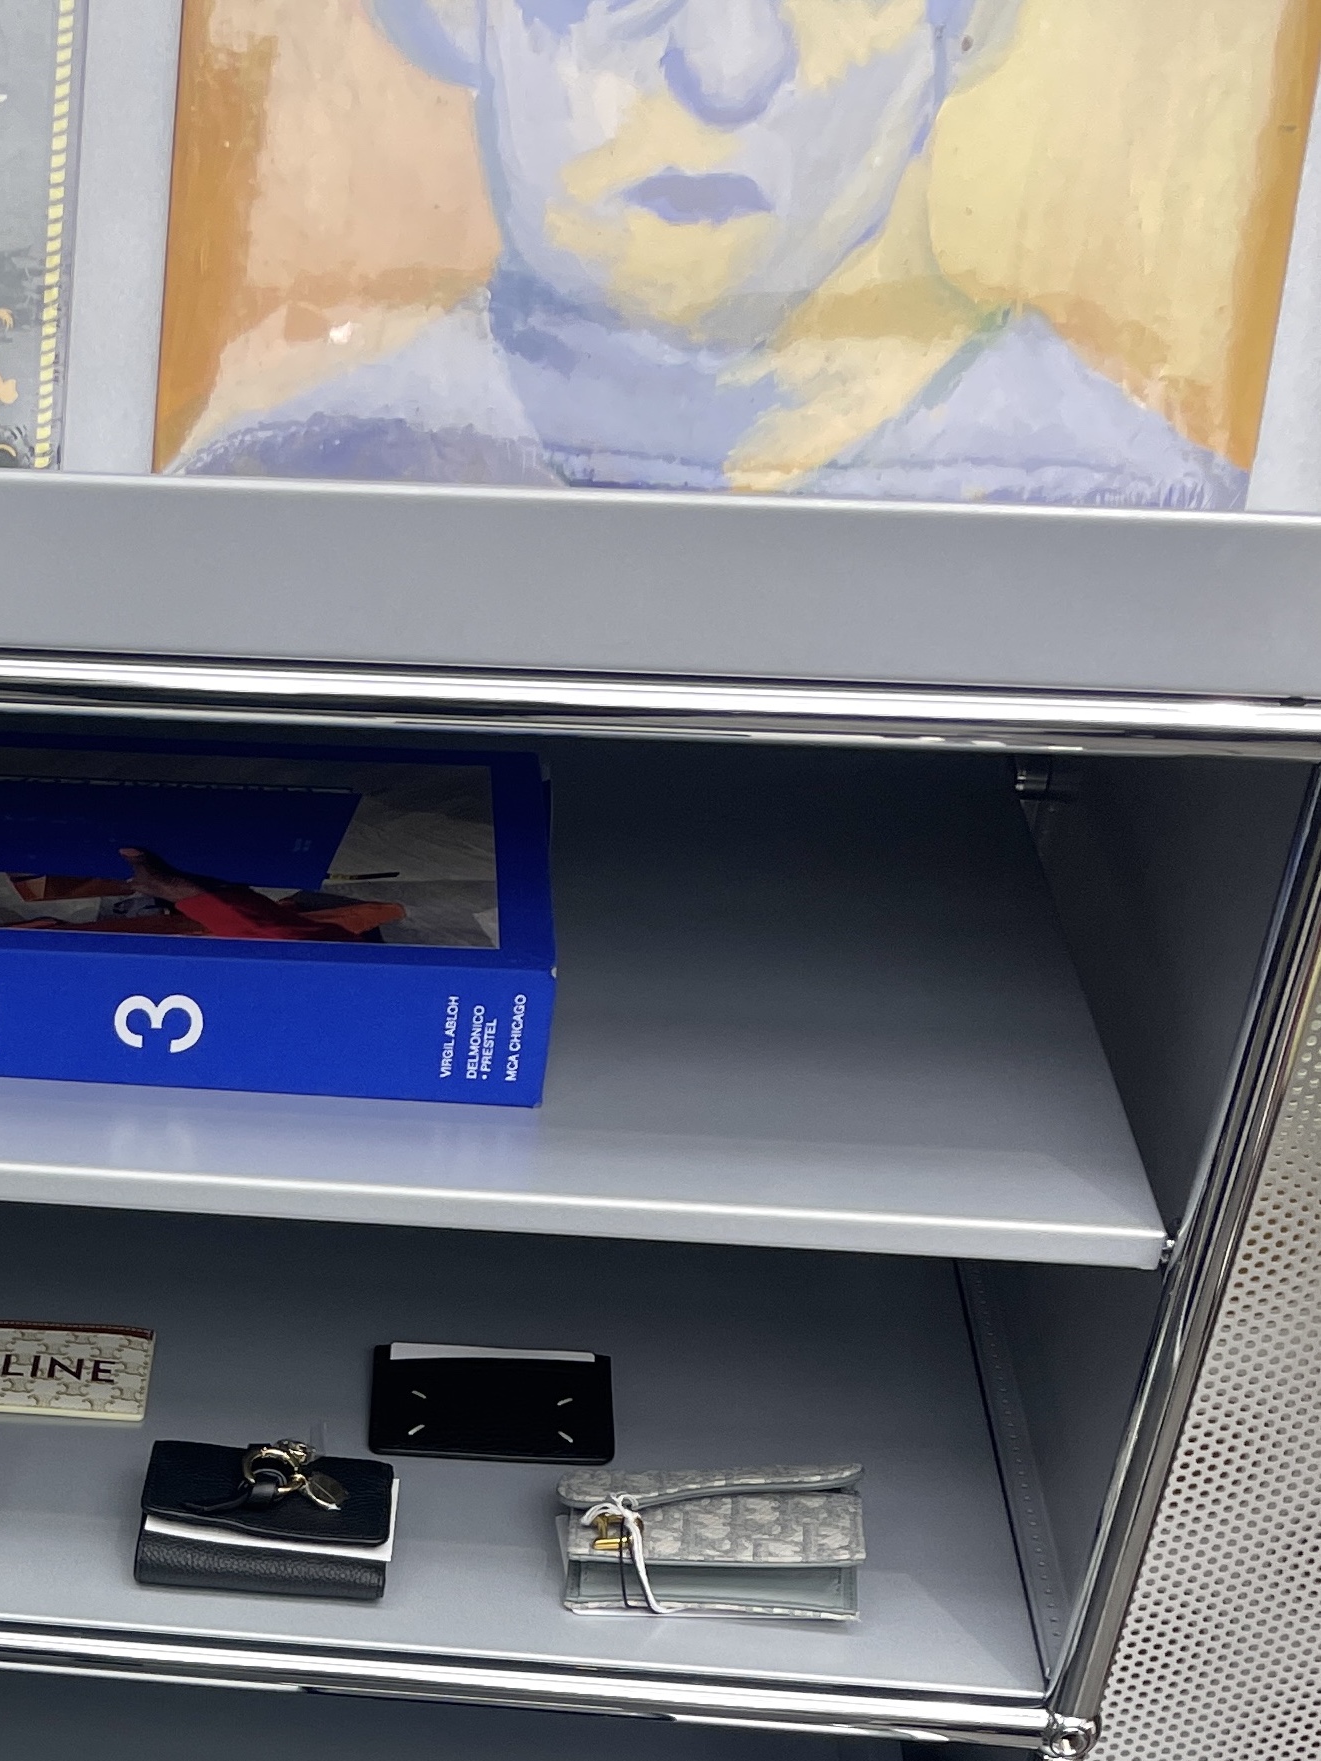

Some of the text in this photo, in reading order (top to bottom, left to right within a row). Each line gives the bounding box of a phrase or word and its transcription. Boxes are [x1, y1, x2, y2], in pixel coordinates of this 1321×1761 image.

[114, 994, 204, 1053] 3
[439, 995, 460, 1078] VIRGIL ABLOH
[465, 1004, 485, 1079] DELMONICO
[480, 1018, 497, 1072] PRESTEL
[504, 994, 527, 1082] MCA CHICAGO
